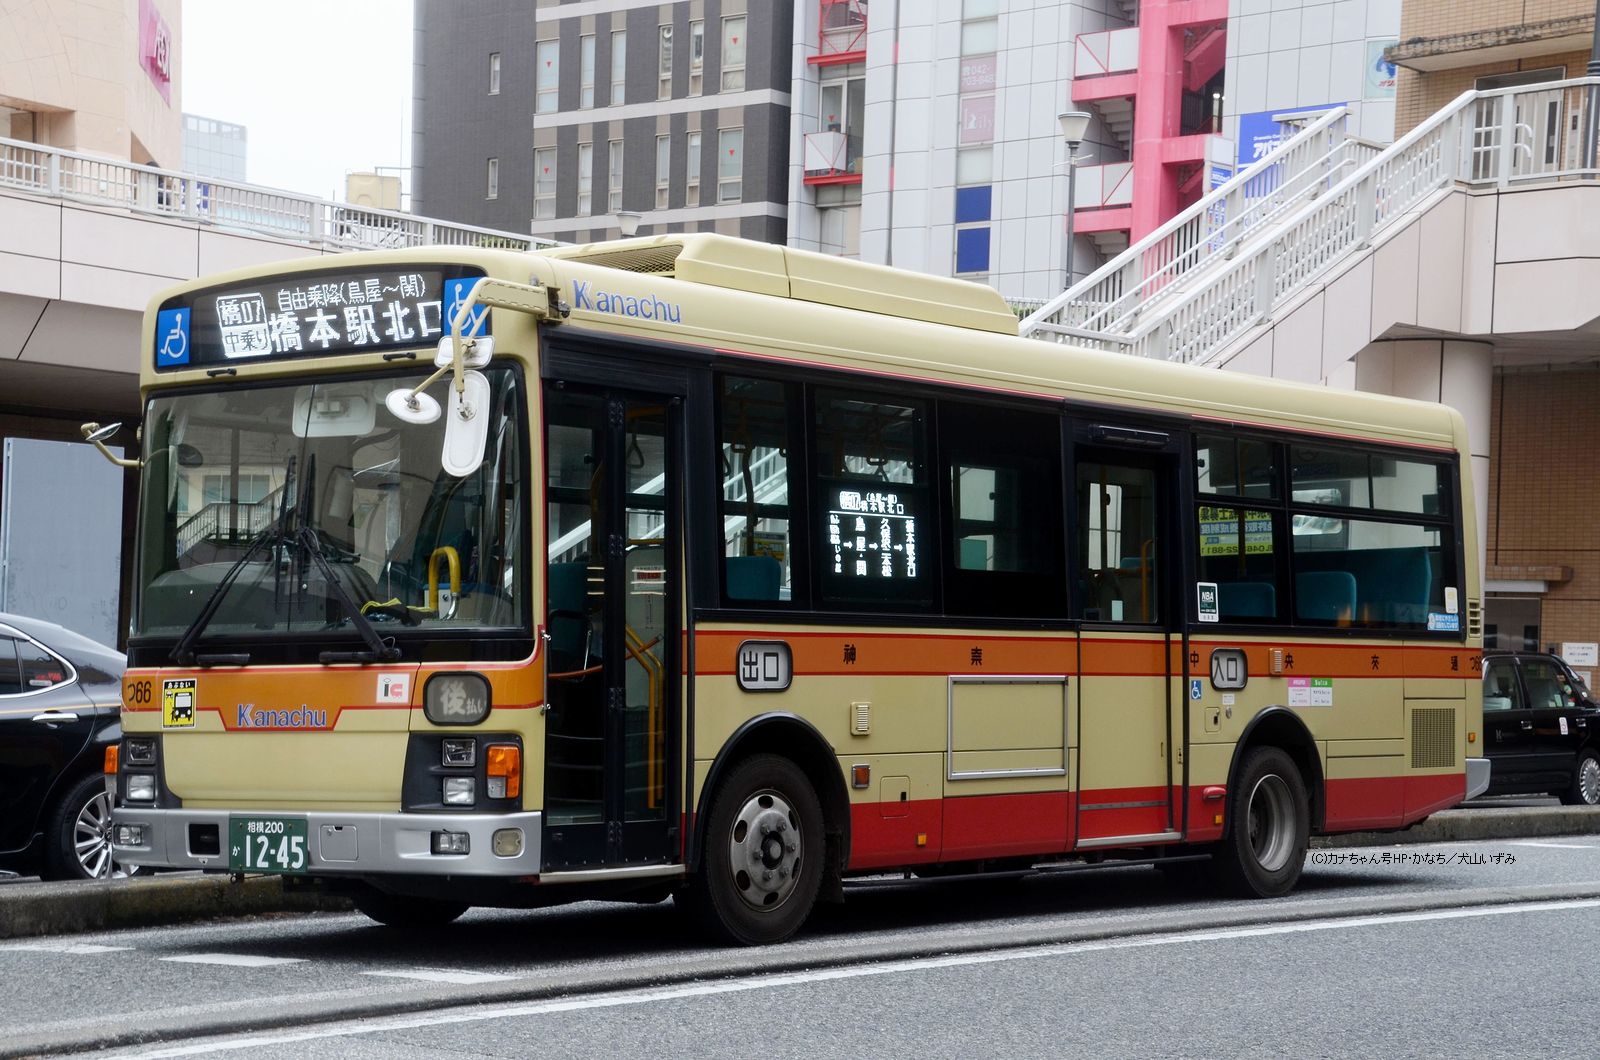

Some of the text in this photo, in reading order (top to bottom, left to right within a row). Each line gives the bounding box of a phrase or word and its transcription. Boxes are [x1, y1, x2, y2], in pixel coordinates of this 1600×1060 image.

[219, 299, 262, 326] 橋07
[573, 279, 681, 324] Kanachu
[224, 327, 270, 352] 中乗り
[269, 300, 442, 352] 橋本駅北口
[743, 651, 779, 681] 出口
[843, 644, 857, 665] 神
[970, 646, 983, 666] 奈
[1190, 650, 1199, 668] 中
[1284, 652, 1294, 669] 央
[1212, 656, 1238, 682] 入口
[440, 680, 483, 715] 後払い
[237, 703, 326, 727] Kanachu
[247, 821, 284, 833] 相模200
[232, 834, 304, 869] か 12-45
